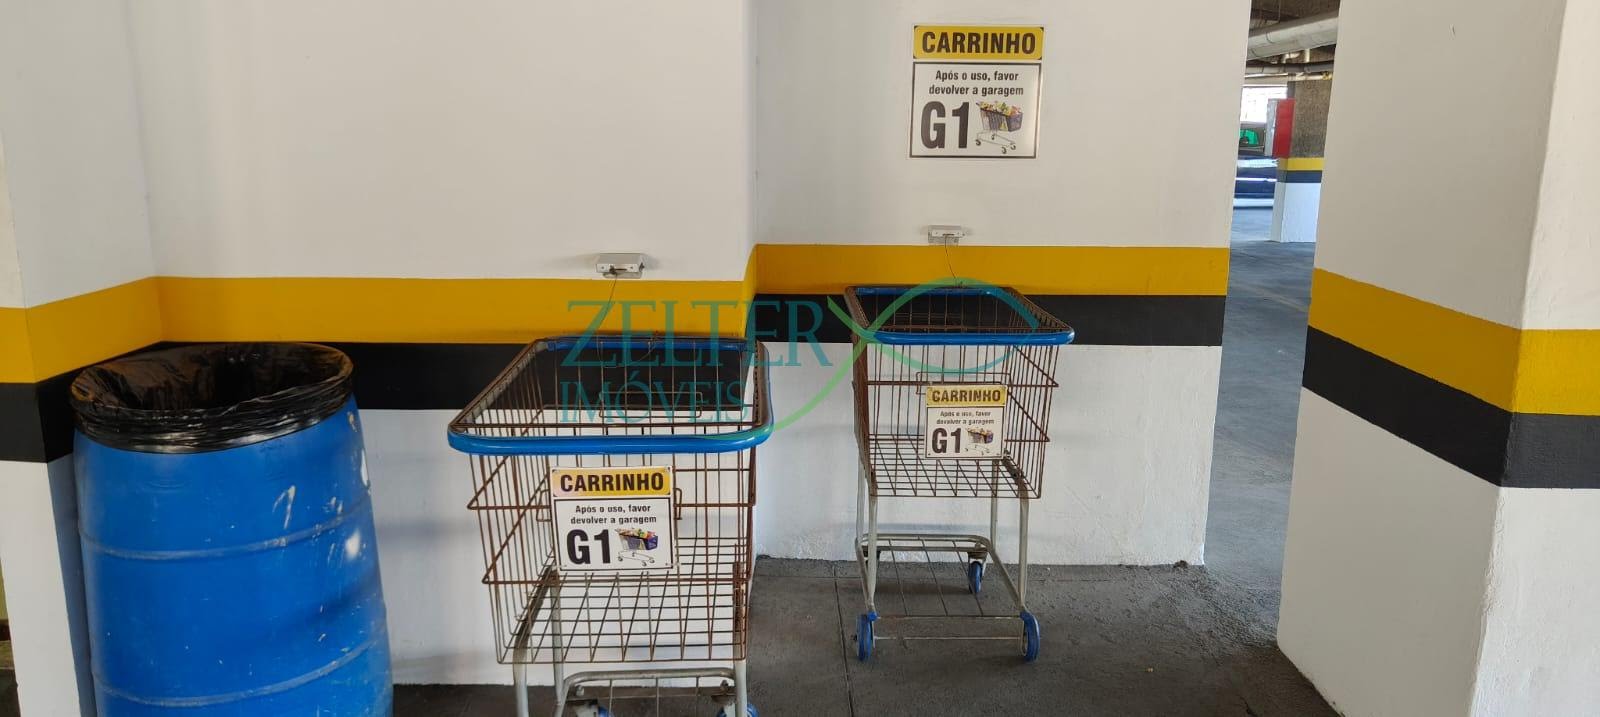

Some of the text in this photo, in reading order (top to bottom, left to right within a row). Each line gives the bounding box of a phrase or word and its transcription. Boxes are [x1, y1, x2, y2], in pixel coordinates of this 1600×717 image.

[922, 31, 1036, 54] CARRINHO
[935, 70, 1019, 82] Após o uso, favor
[929, 84, 1024, 97] devolver a garagem
[921, 101, 969, 149] G1
[932, 390, 1001, 402] CARRINHO
[932, 428, 961, 453] G1
[560, 472, 664, 492] CARRINHO
[575, 505, 597, 514] Após
[608, 505, 626, 513] uso,
[628, 504, 651, 512] favor
[570, 516, 608, 525] devolver
[619, 516, 657, 525] garagem
[566, 529, 611, 565] G1
